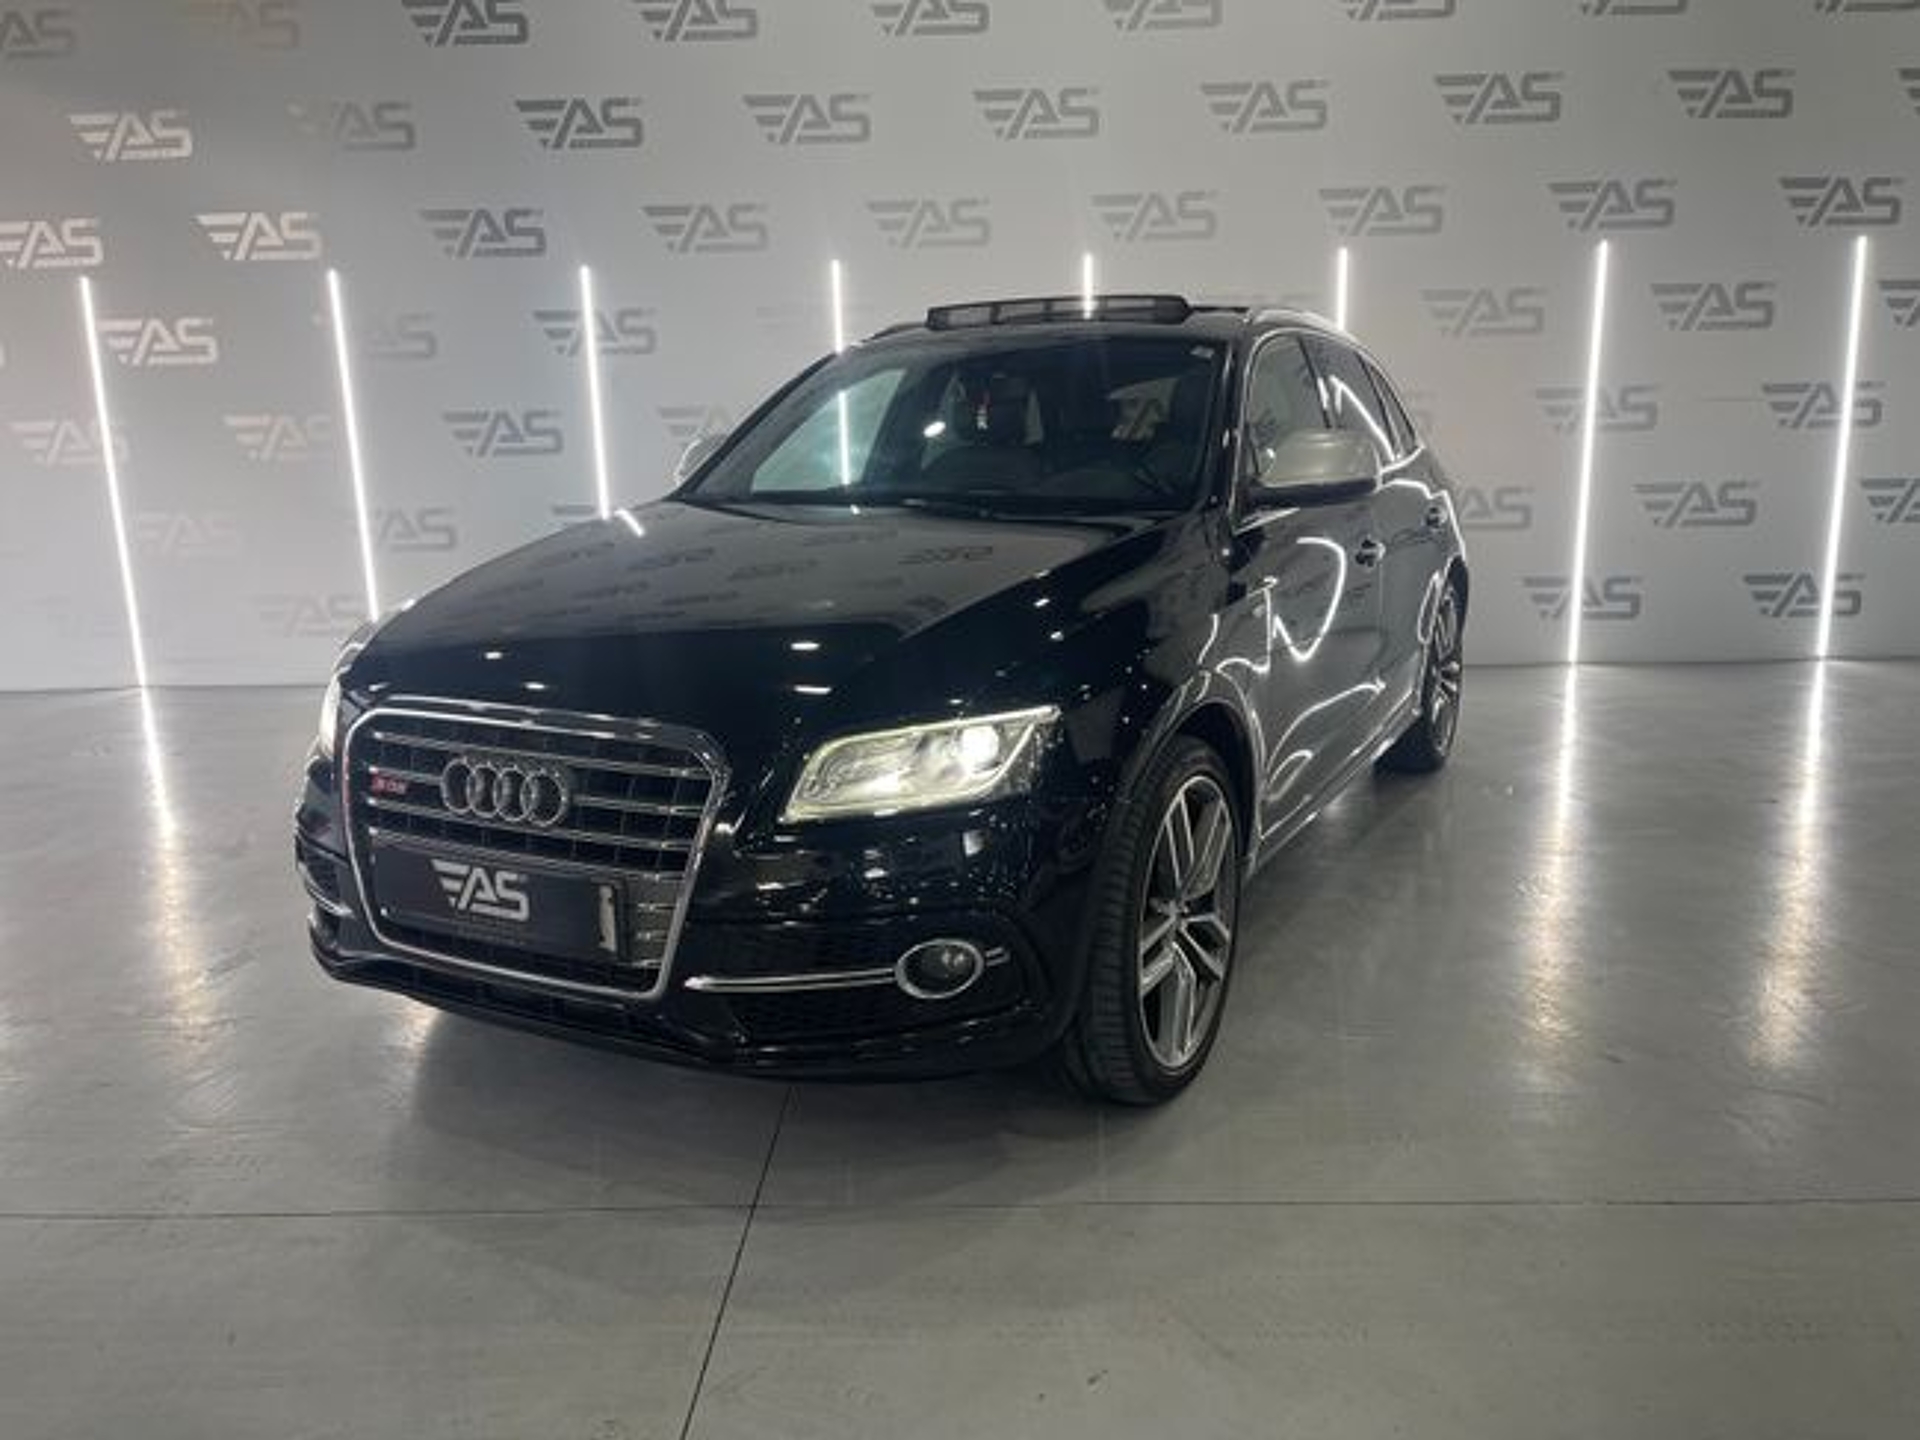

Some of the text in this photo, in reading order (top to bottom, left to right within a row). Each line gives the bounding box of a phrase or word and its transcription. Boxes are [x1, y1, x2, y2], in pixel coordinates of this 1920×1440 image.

[779, 93, 871, 144] AS
[1006, 88, 1100, 139] AS
[1231, 80, 1330, 133] AS
[1465, 72, 1564, 124] AS
[1698, 69, 1795, 118] AS
[551, 98, 644, 149] AS
[901, 200, 990, 249] AS
[1126, 191, 1217, 241] AS
[1350, 186, 1446, 236] AS
[1580, 179, 1677, 231] AS
[1808, 177, 1904, 227] AS
[456, 209, 547, 258] AS
[678, 205, 769, 253] AS
[1680, 282, 1778, 330] AS
[477, 409, 563, 457] AS
[457, 867, 530, 921] AS
